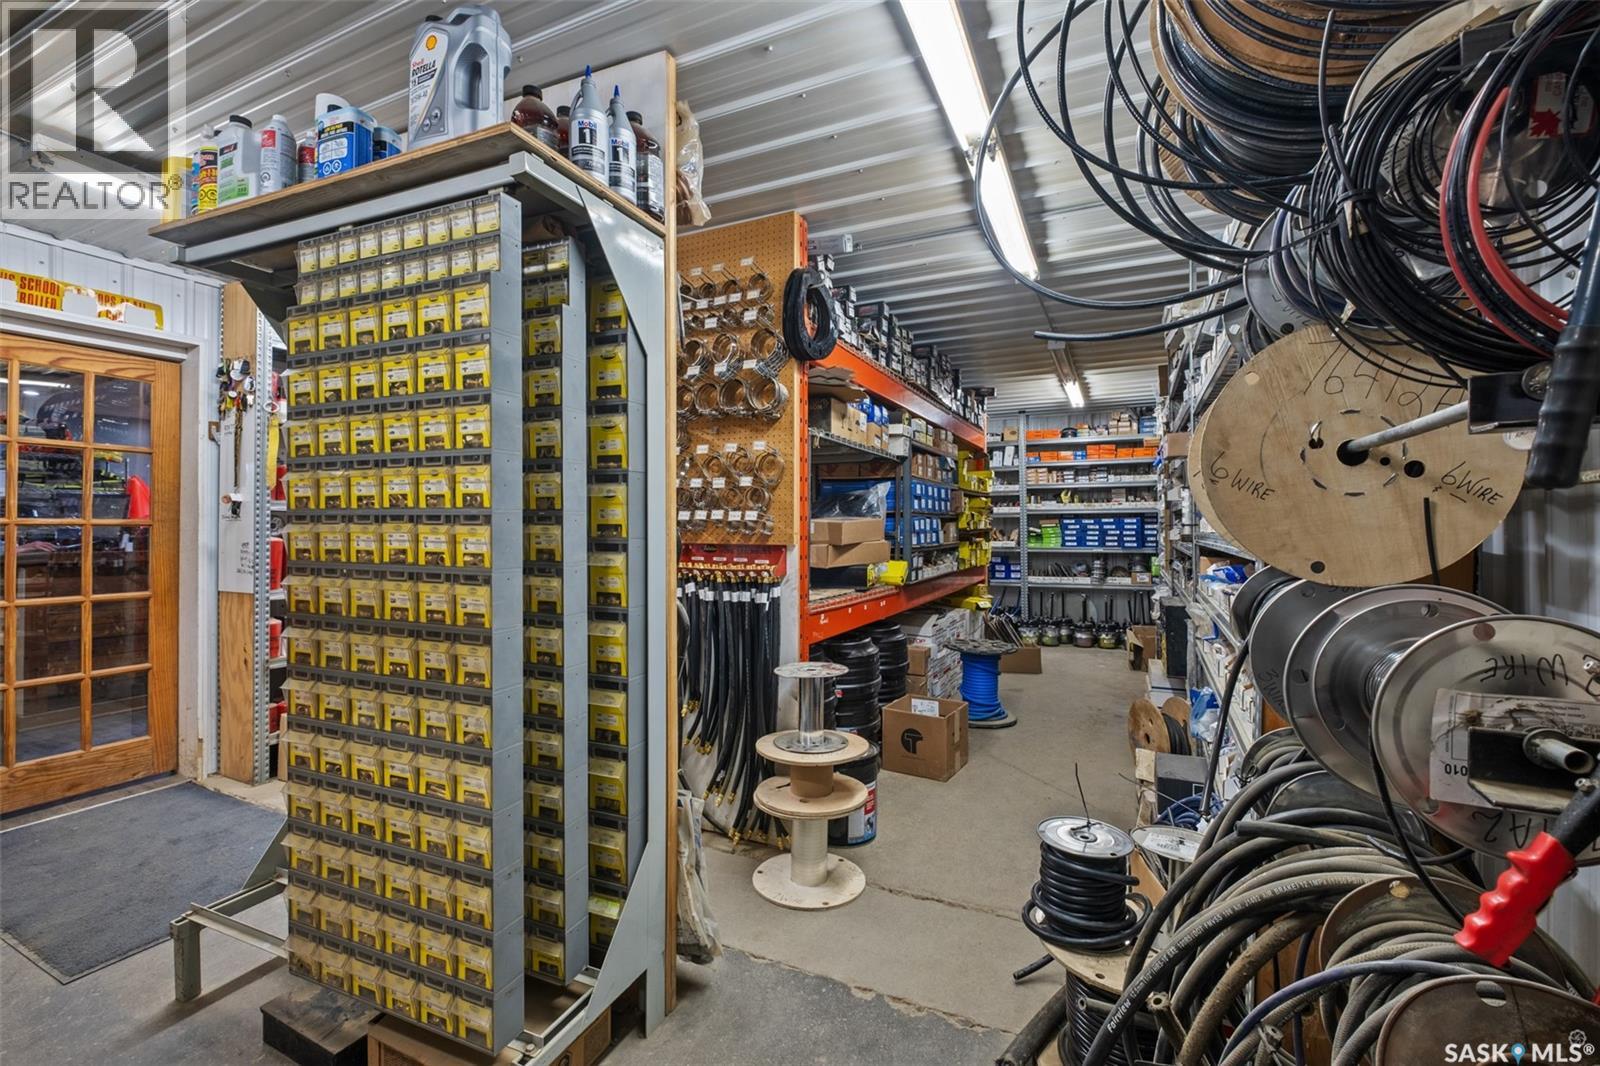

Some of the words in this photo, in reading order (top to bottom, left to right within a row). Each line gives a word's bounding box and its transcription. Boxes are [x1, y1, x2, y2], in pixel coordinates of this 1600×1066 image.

[412, 60, 436, 77] ROTELLA
[578, 119, 598, 130] Mobil
[611, 138, 629, 150] Mobil
[20, 276, 60, 297] SCHOOL
[1210, 450, 1229, 479] 6
[1231, 468, 1276, 501] WIRE
[1441, 460, 1466, 486] 6
[1456, 470, 1504, 505] WIRE
[1480, 653, 1569, 687] WIRE
[1106, 998, 1132, 1033] Fairview
